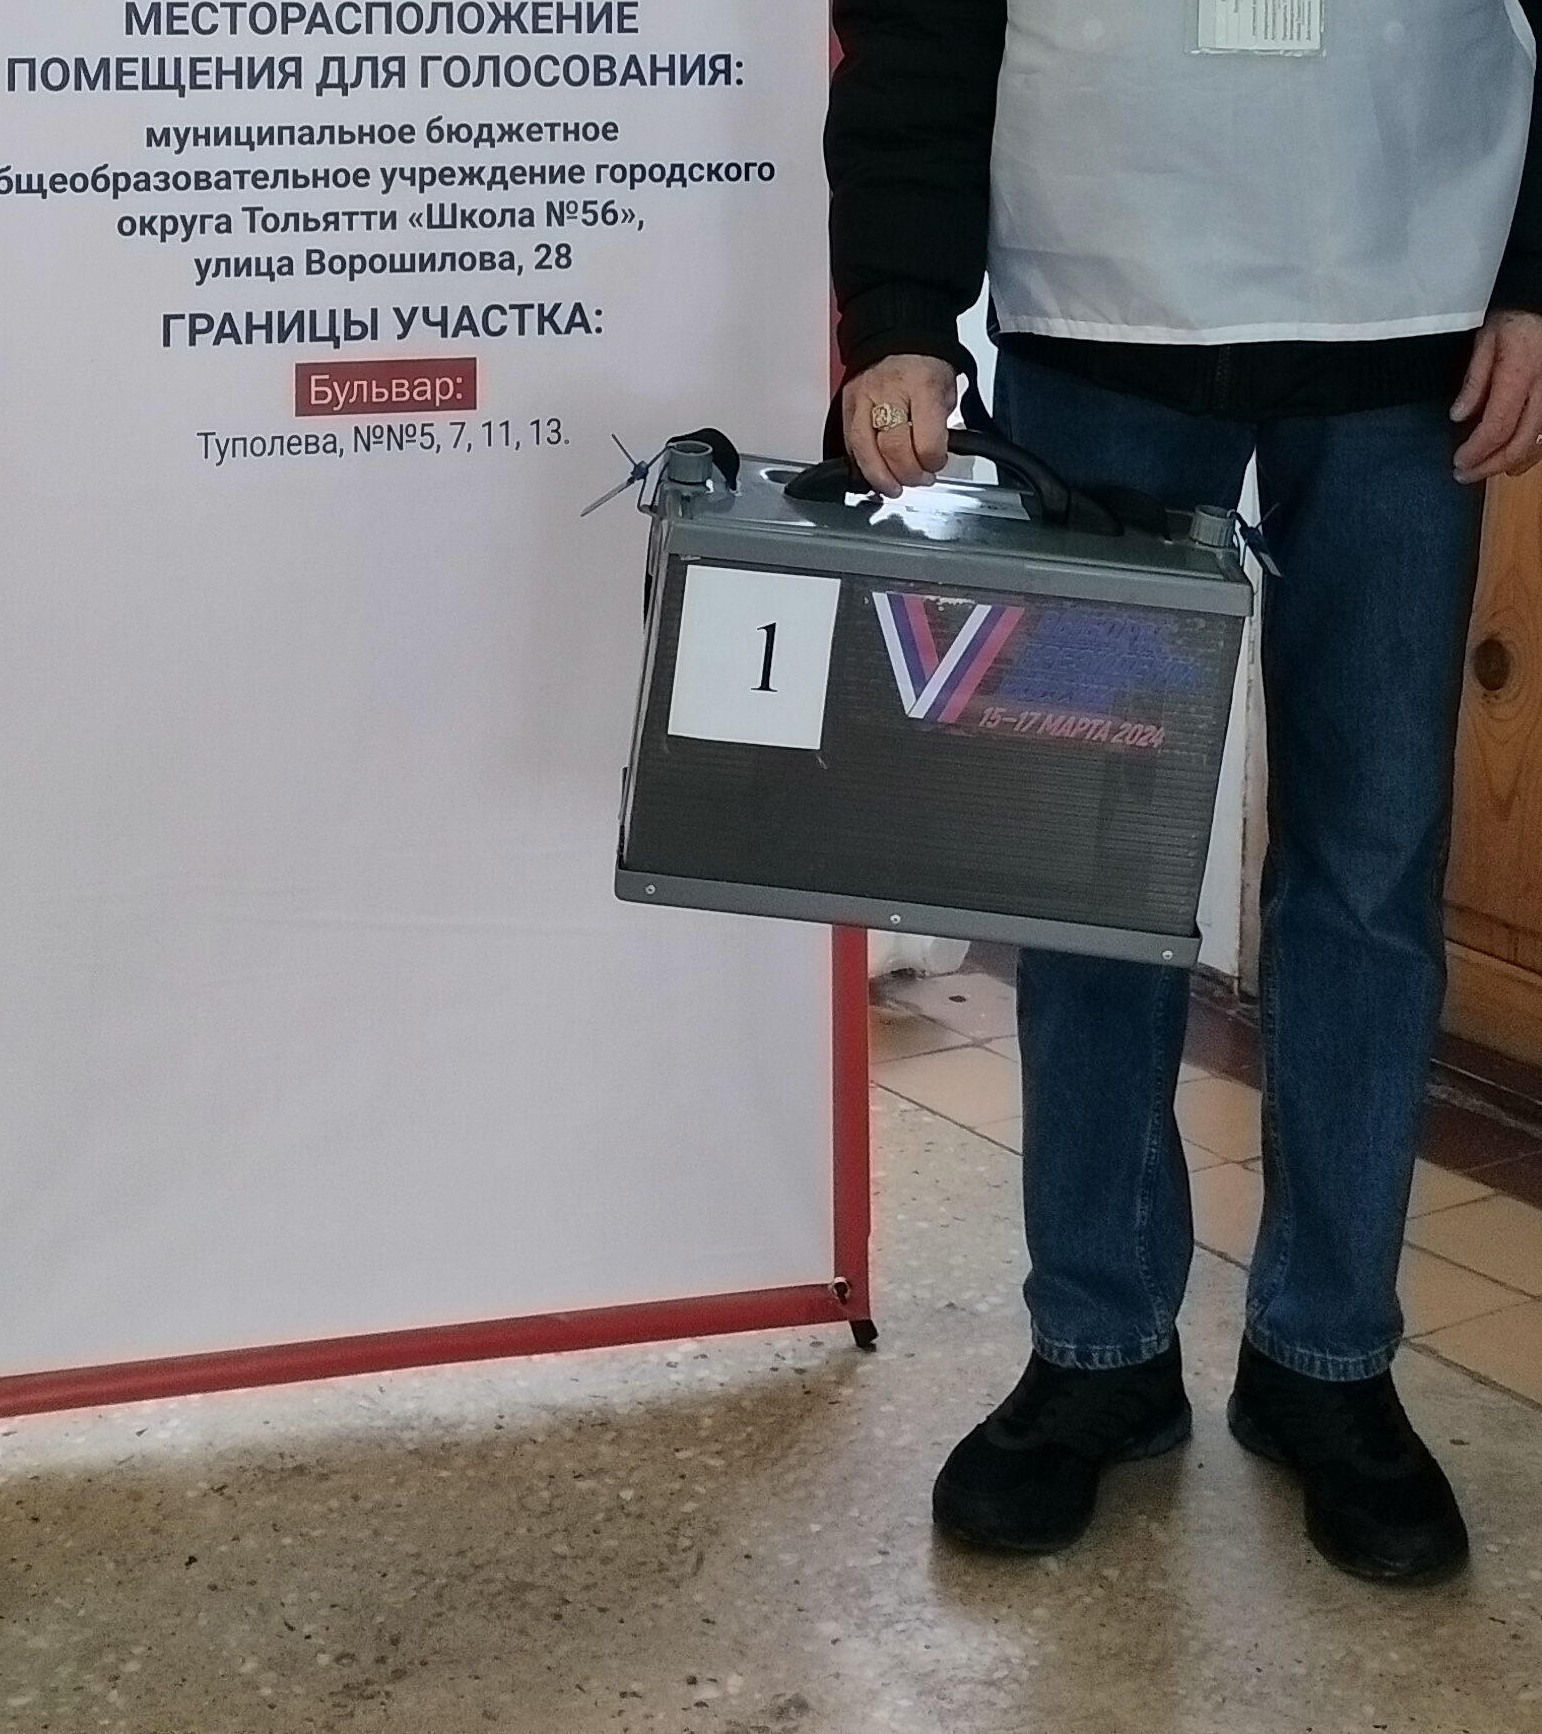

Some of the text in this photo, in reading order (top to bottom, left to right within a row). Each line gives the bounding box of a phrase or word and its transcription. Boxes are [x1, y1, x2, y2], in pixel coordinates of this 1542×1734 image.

[124, 1, 640, 37] МЕСТОРАСПОЛОЖЕНИЕ
[6, 53, 744, 98] ПОМЕЩЕНИЯ ДЛЯ ГОЛОСОВАНИЯ:
[146, 116, 619, 154] муниципальное бюджетное
[380, 163, 585, 194] учреждение
[595, 161, 775, 190] городского
[117, 200, 645, 242] округа Тольятти «Школа №56»,
[194, 243, 573, 285] улица Ворошилова, 28
[162, 302, 604, 349] ГРАНИЦЫ УЧАСТКА:
[308, 372, 465, 409] Бульвар:
[196, 417, 571, 466] Туполева, №№5, 7, 11, 13.
[750, 621, 778, 693] 1
[1036, 713, 1113, 743] МАРТА
[1110, 722, 1166, 749] 2024
